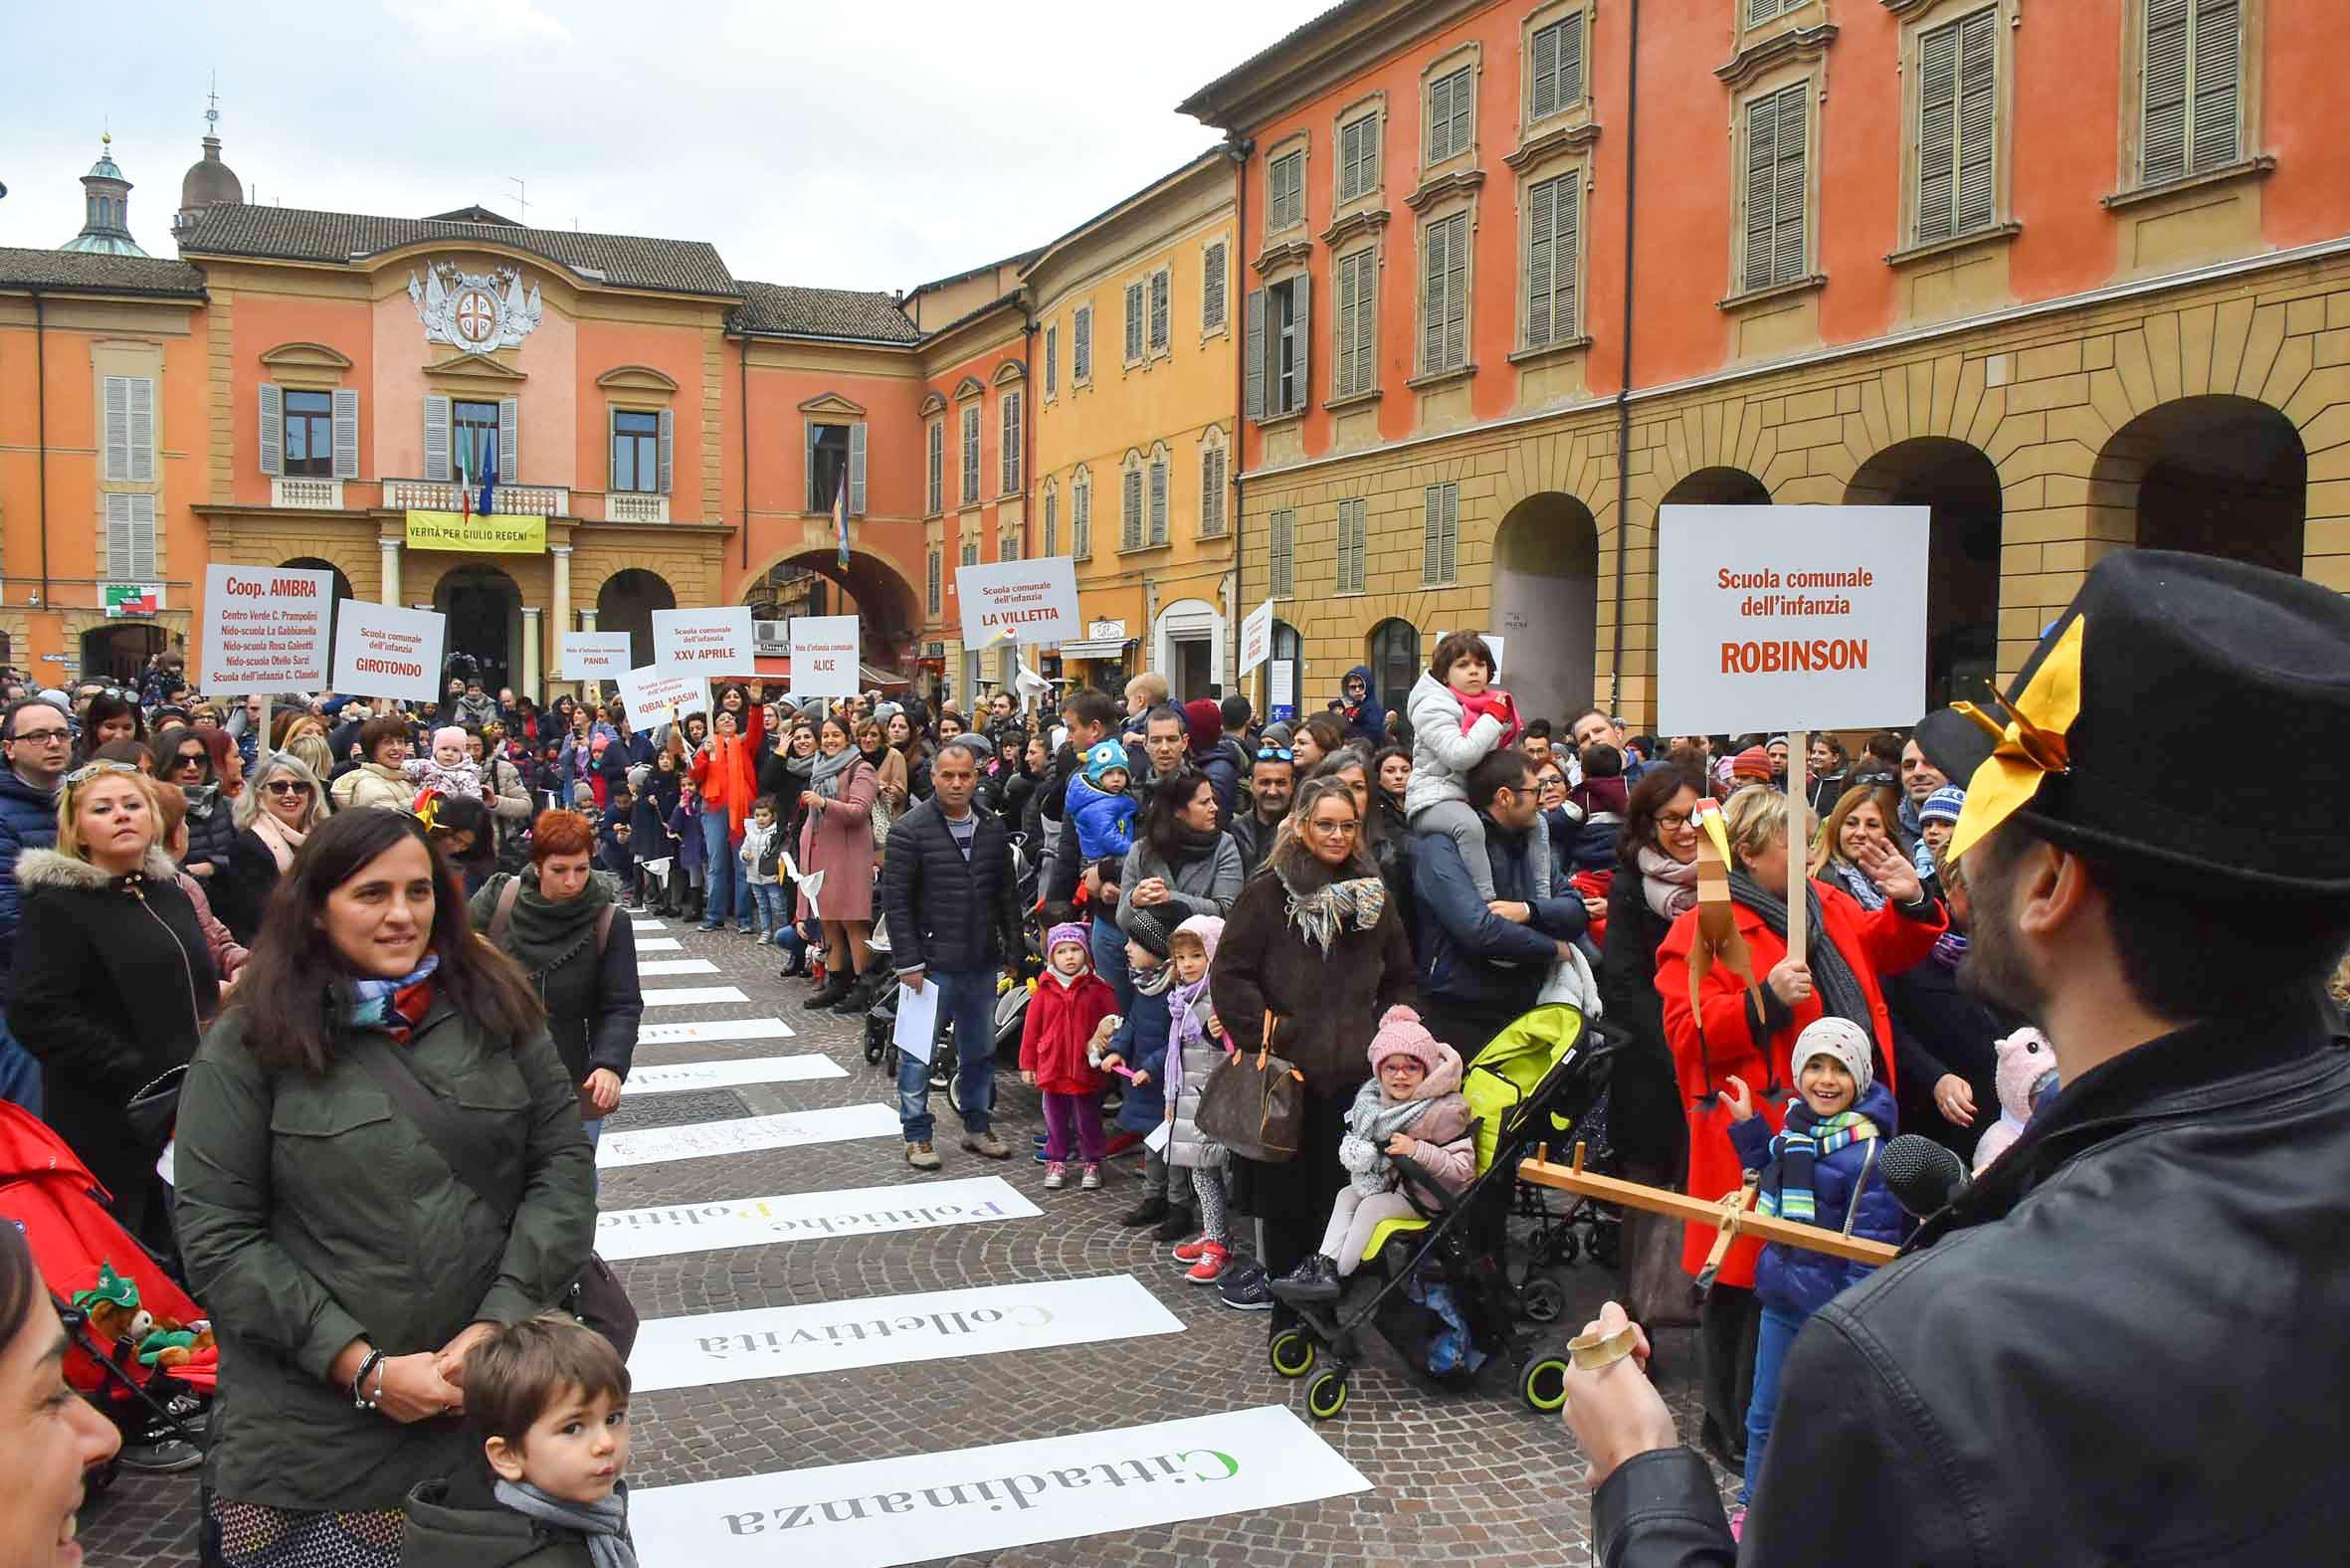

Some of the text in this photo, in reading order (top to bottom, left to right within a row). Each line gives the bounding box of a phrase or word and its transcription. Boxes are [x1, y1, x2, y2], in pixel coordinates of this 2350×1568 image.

[410, 525, 439, 537] VERITÀ
[443, 528, 460, 538] PER
[463, 530, 492, 540] GIULIO
[495, 531, 527, 541] REGENI
[1717, 566, 1873, 590] Scuola comunale
[226, 577, 317, 599] Coop. AMBRA
[981, 581, 1052, 596] Scuola comunale
[994, 593, 1043, 606] dell'infanzia
[1741, 594, 1851, 617] dell'infanzia
[222, 609, 248, 621] Centro
[249, 610, 271, 621] Verde
[982, 607, 1060, 627] LA VILLETTA
[221, 625, 266, 636] Nido-scuola
[267, 626, 276, 636] La
[360, 627, 423, 645] Scuola comunale
[675, 626, 732, 636] Scuola comunale
[223, 640, 267, 651] Nido-scuola
[269, 641, 287, 651] Rosa
[369, 641, 413, 654] dell'infanzia
[226, 656, 270, 667] Nido-scuola
[674, 648, 736, 662] XXV APRILE
[1720, 639, 1869, 674] ROBINSON
[356, 658, 422, 678] GIROTONDO
[813, 660, 835, 672] ALICE
[213, 672, 239, 683] Scuola
[638, 699, 667, 714] IQBAL
[770, 1201, 1009, 1235] Politiche
[694, 1303, 1056, 1360] Collettività
[719, 1449, 1241, 1537] Cittadinanza
